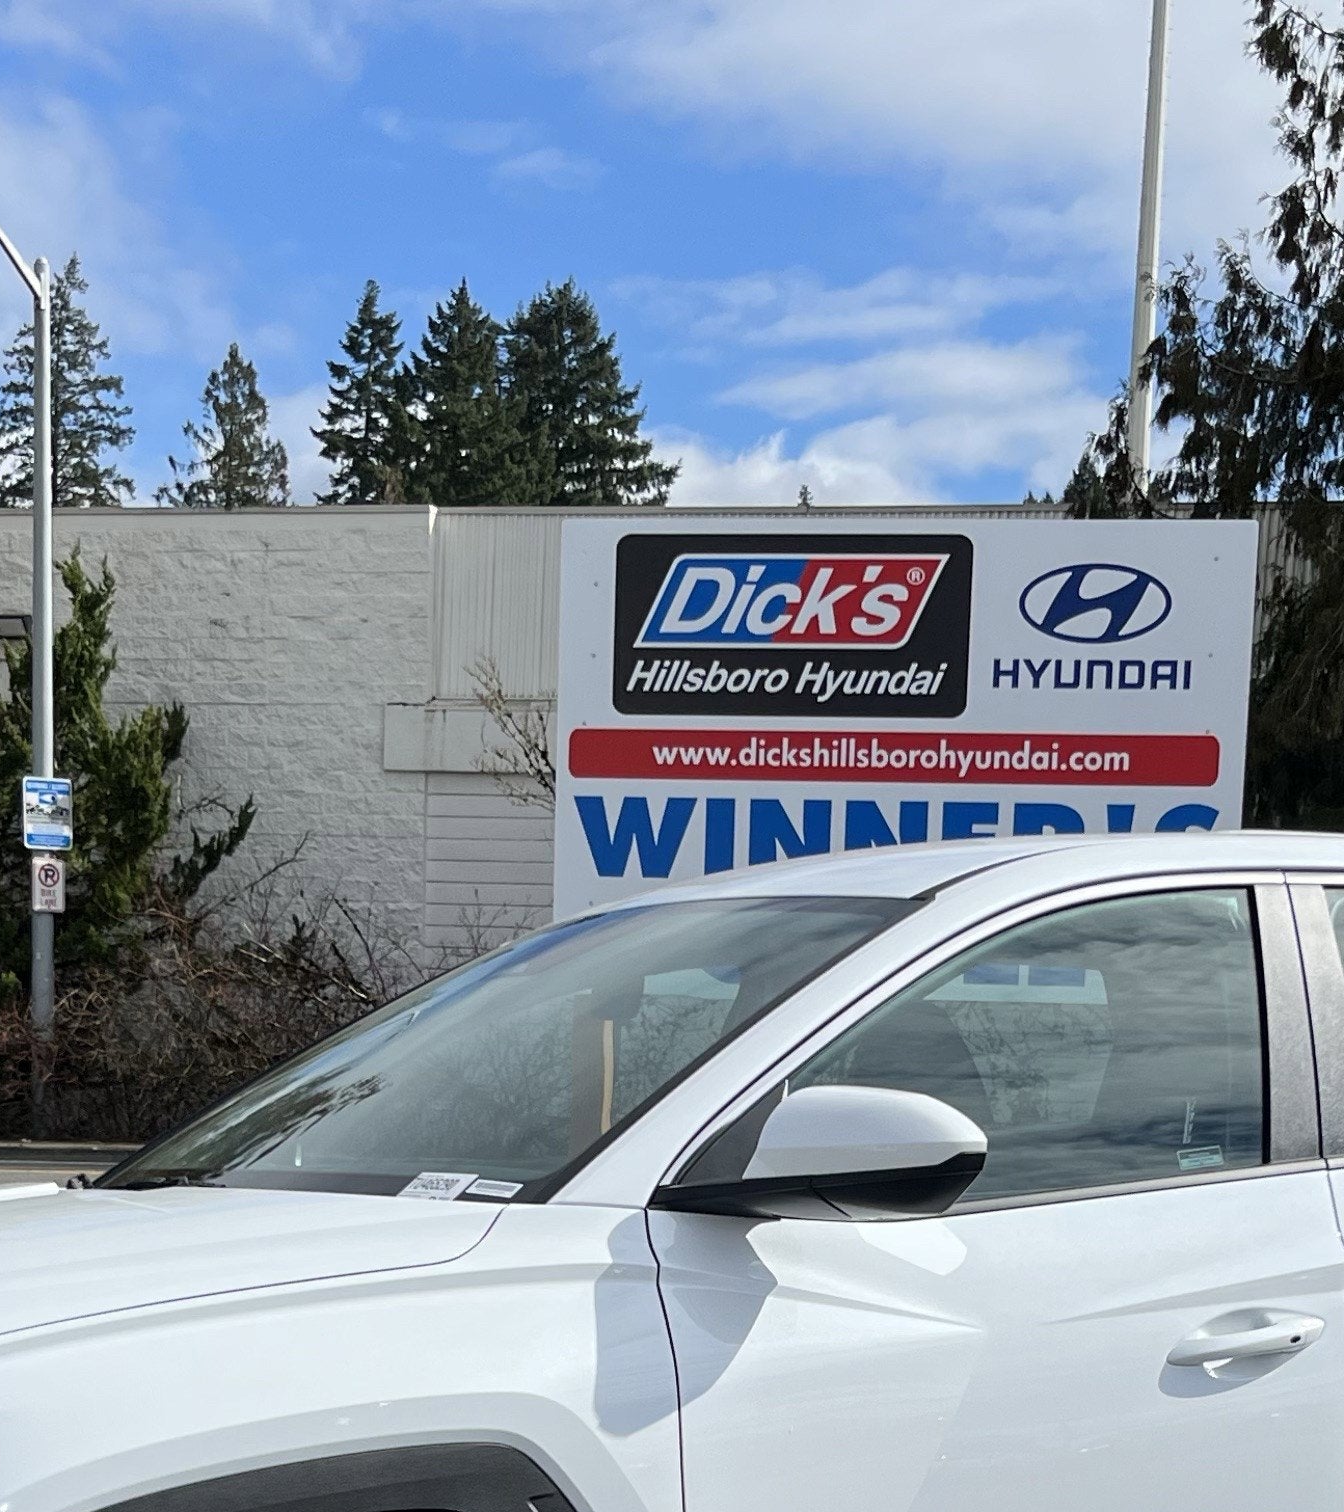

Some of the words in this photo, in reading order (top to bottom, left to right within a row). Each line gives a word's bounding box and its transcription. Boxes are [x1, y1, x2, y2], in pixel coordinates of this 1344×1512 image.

[626, 660, 789, 693] Hillsboro
[795, 661, 948, 702] Hyundai
[992, 658, 1192, 690] HYUNDAI
[653, 737, 1131, 779] www.dickshillsborohyundai.com
